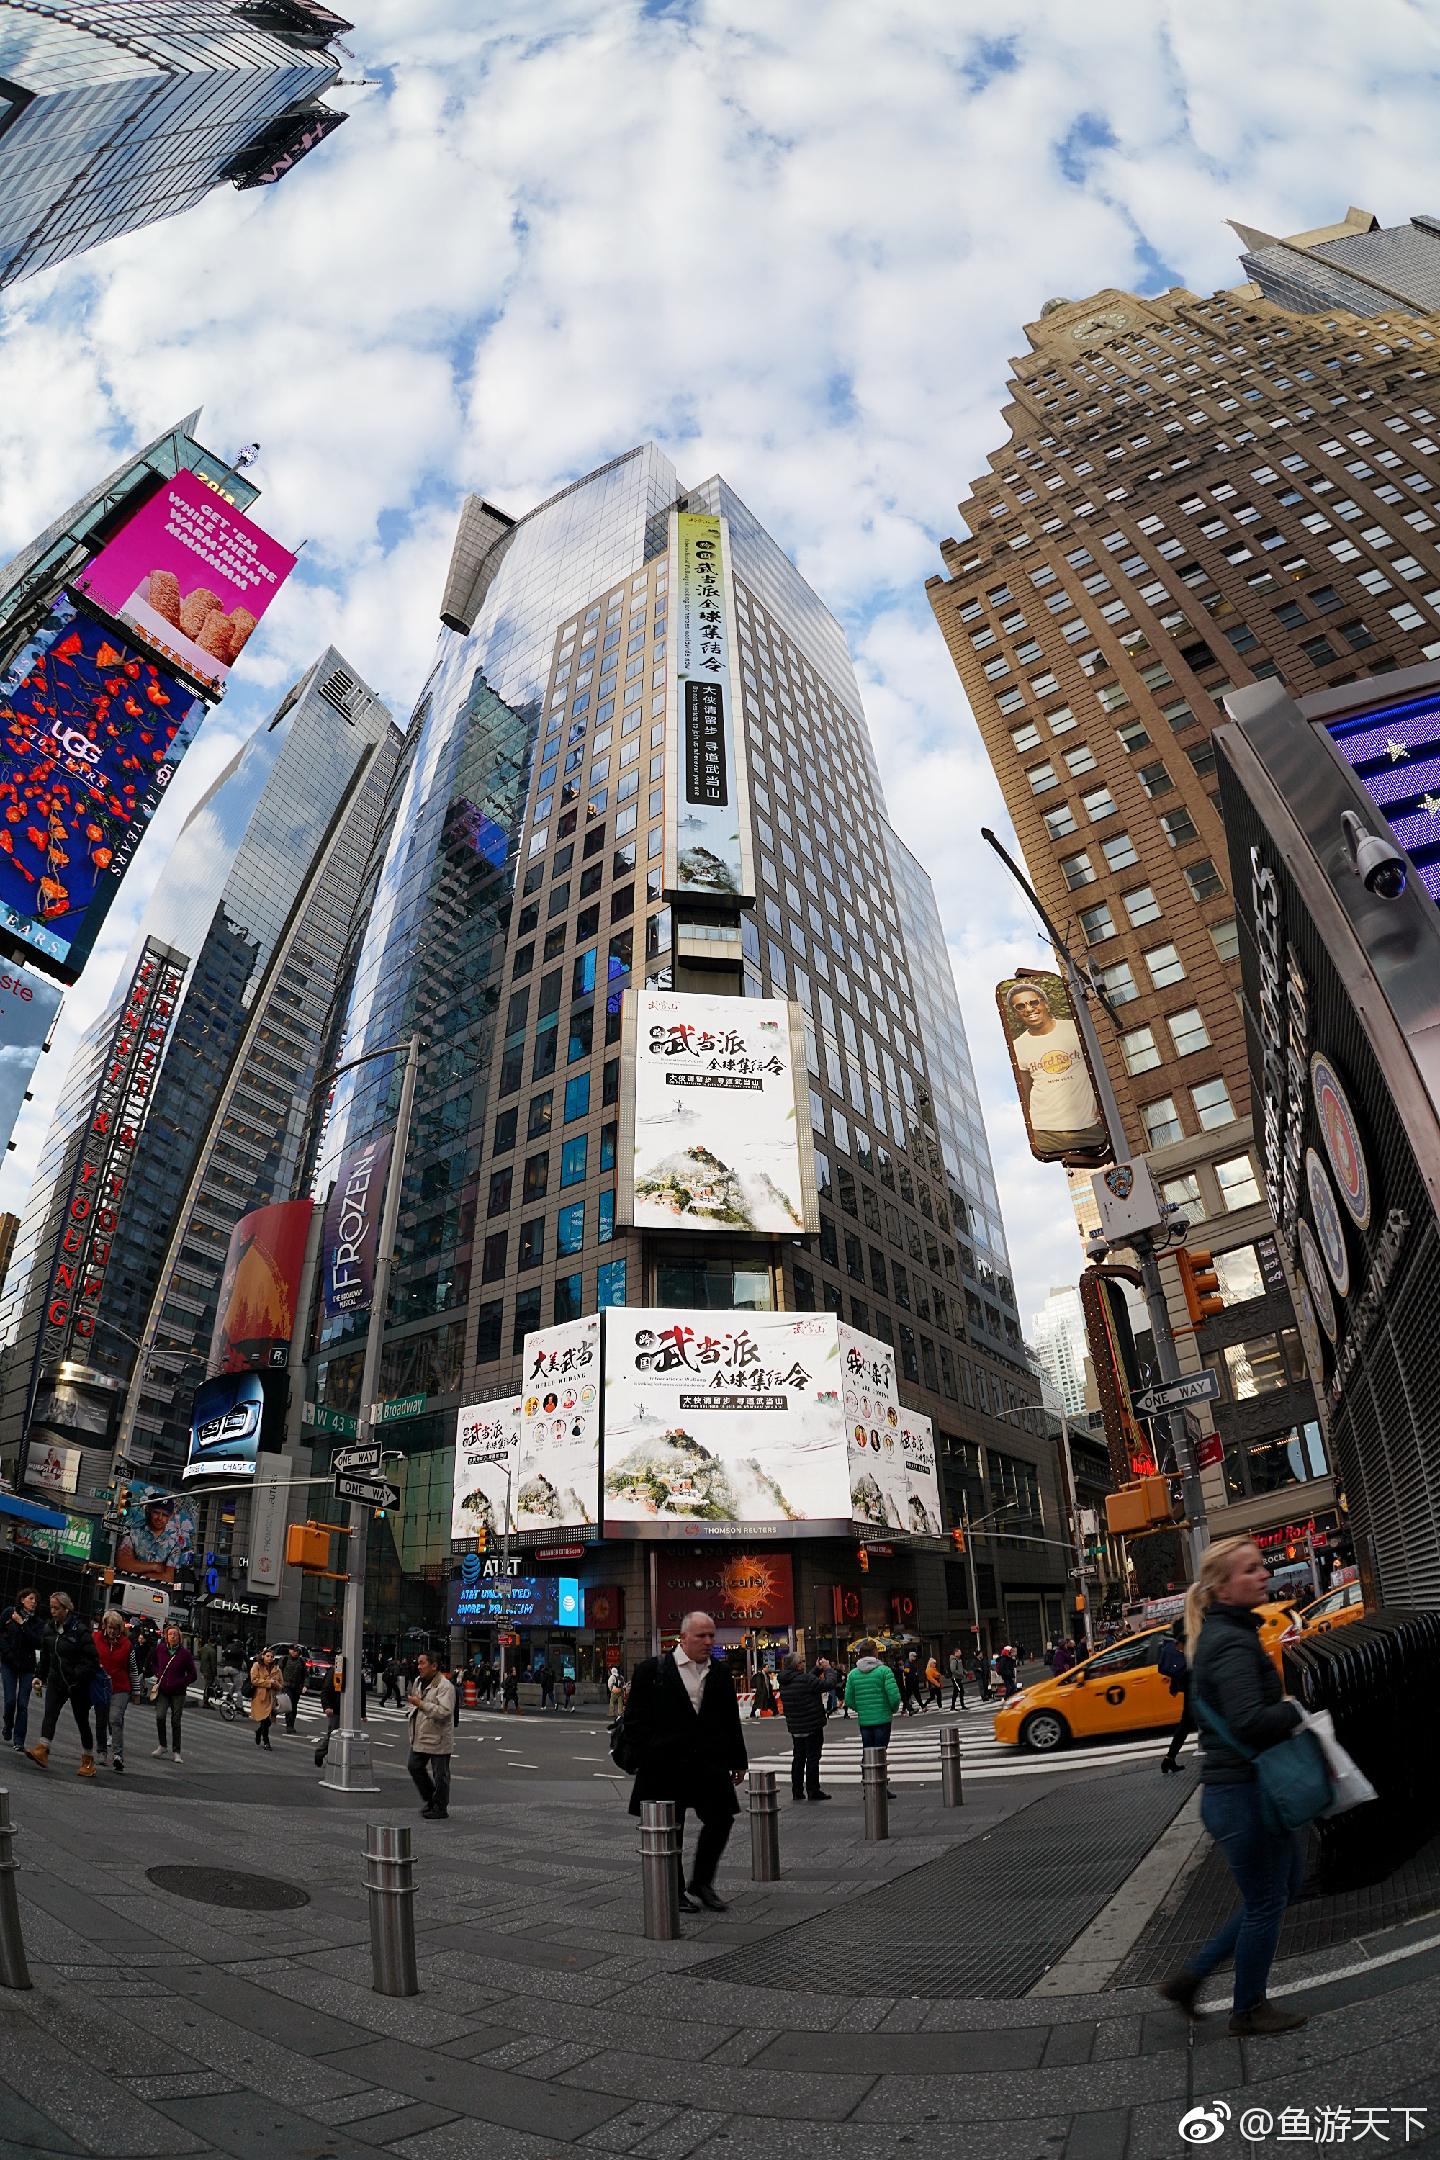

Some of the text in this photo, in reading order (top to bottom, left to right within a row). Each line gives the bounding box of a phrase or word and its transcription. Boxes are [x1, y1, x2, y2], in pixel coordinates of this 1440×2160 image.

[201, 504, 230, 529] GET
[168, 491, 277, 584] WHILE THEY'RE
[28, 732, 47, 747] 40
[51, 719, 103, 764] UGG
[110, 763, 175, 877] UGG 40 YEARS
[1056, 1049, 1081, 1064] Rock
[333, 1154, 375, 1291] FROZEN
[49, 1161, 97, 1327] YOUNG
[1144, 1381, 1205, 1409] ONE WAY
[383, 1399, 423, 1419] Broadway
[317, 1409, 327, 1427] W
[331, 1415, 345, 1432] 43
[222, 1463, 247, 1471] CHASE
[338, 1451, 375, 1467] ONE WAY
[345, 1481, 391, 1502] ONE WAY
[703, 1526, 777, 1535] THOMSON REUTERS
[667, 1574, 723, 1591] europa
[213, 1599, 259, 1615] CHASE
